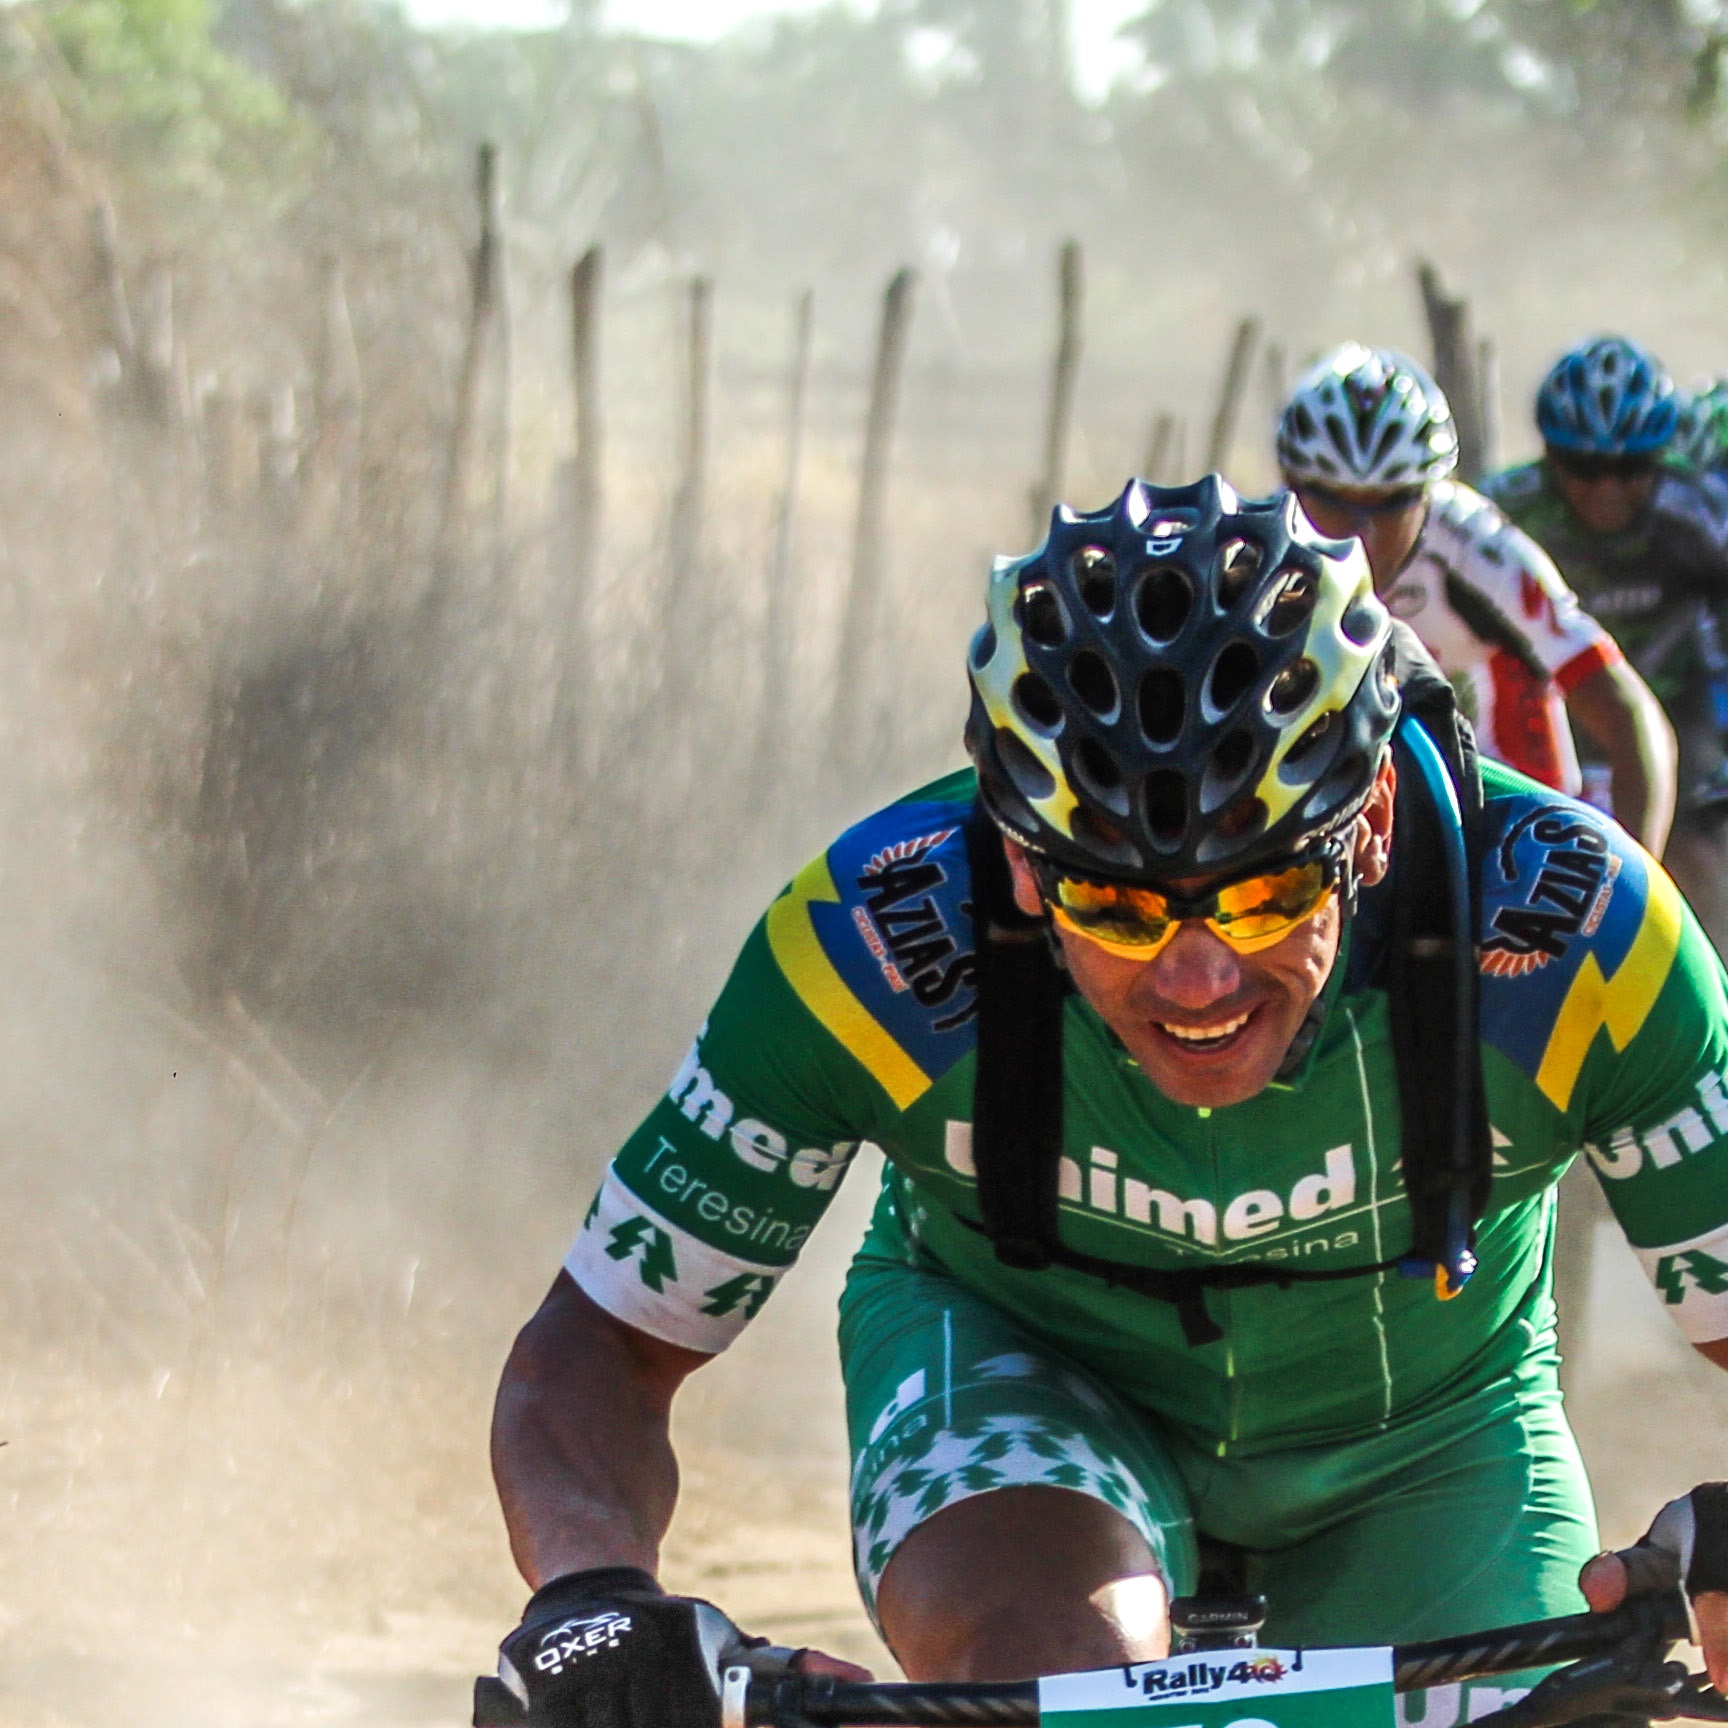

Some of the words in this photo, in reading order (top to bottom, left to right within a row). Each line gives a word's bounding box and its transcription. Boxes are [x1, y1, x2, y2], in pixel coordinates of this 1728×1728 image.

[1491, 819, 1609, 960] AZIAS
[669, 1040, 856, 1191] med
[644, 1134, 813, 1251] Teresina
[533, 1616, 633, 1662] OXER
